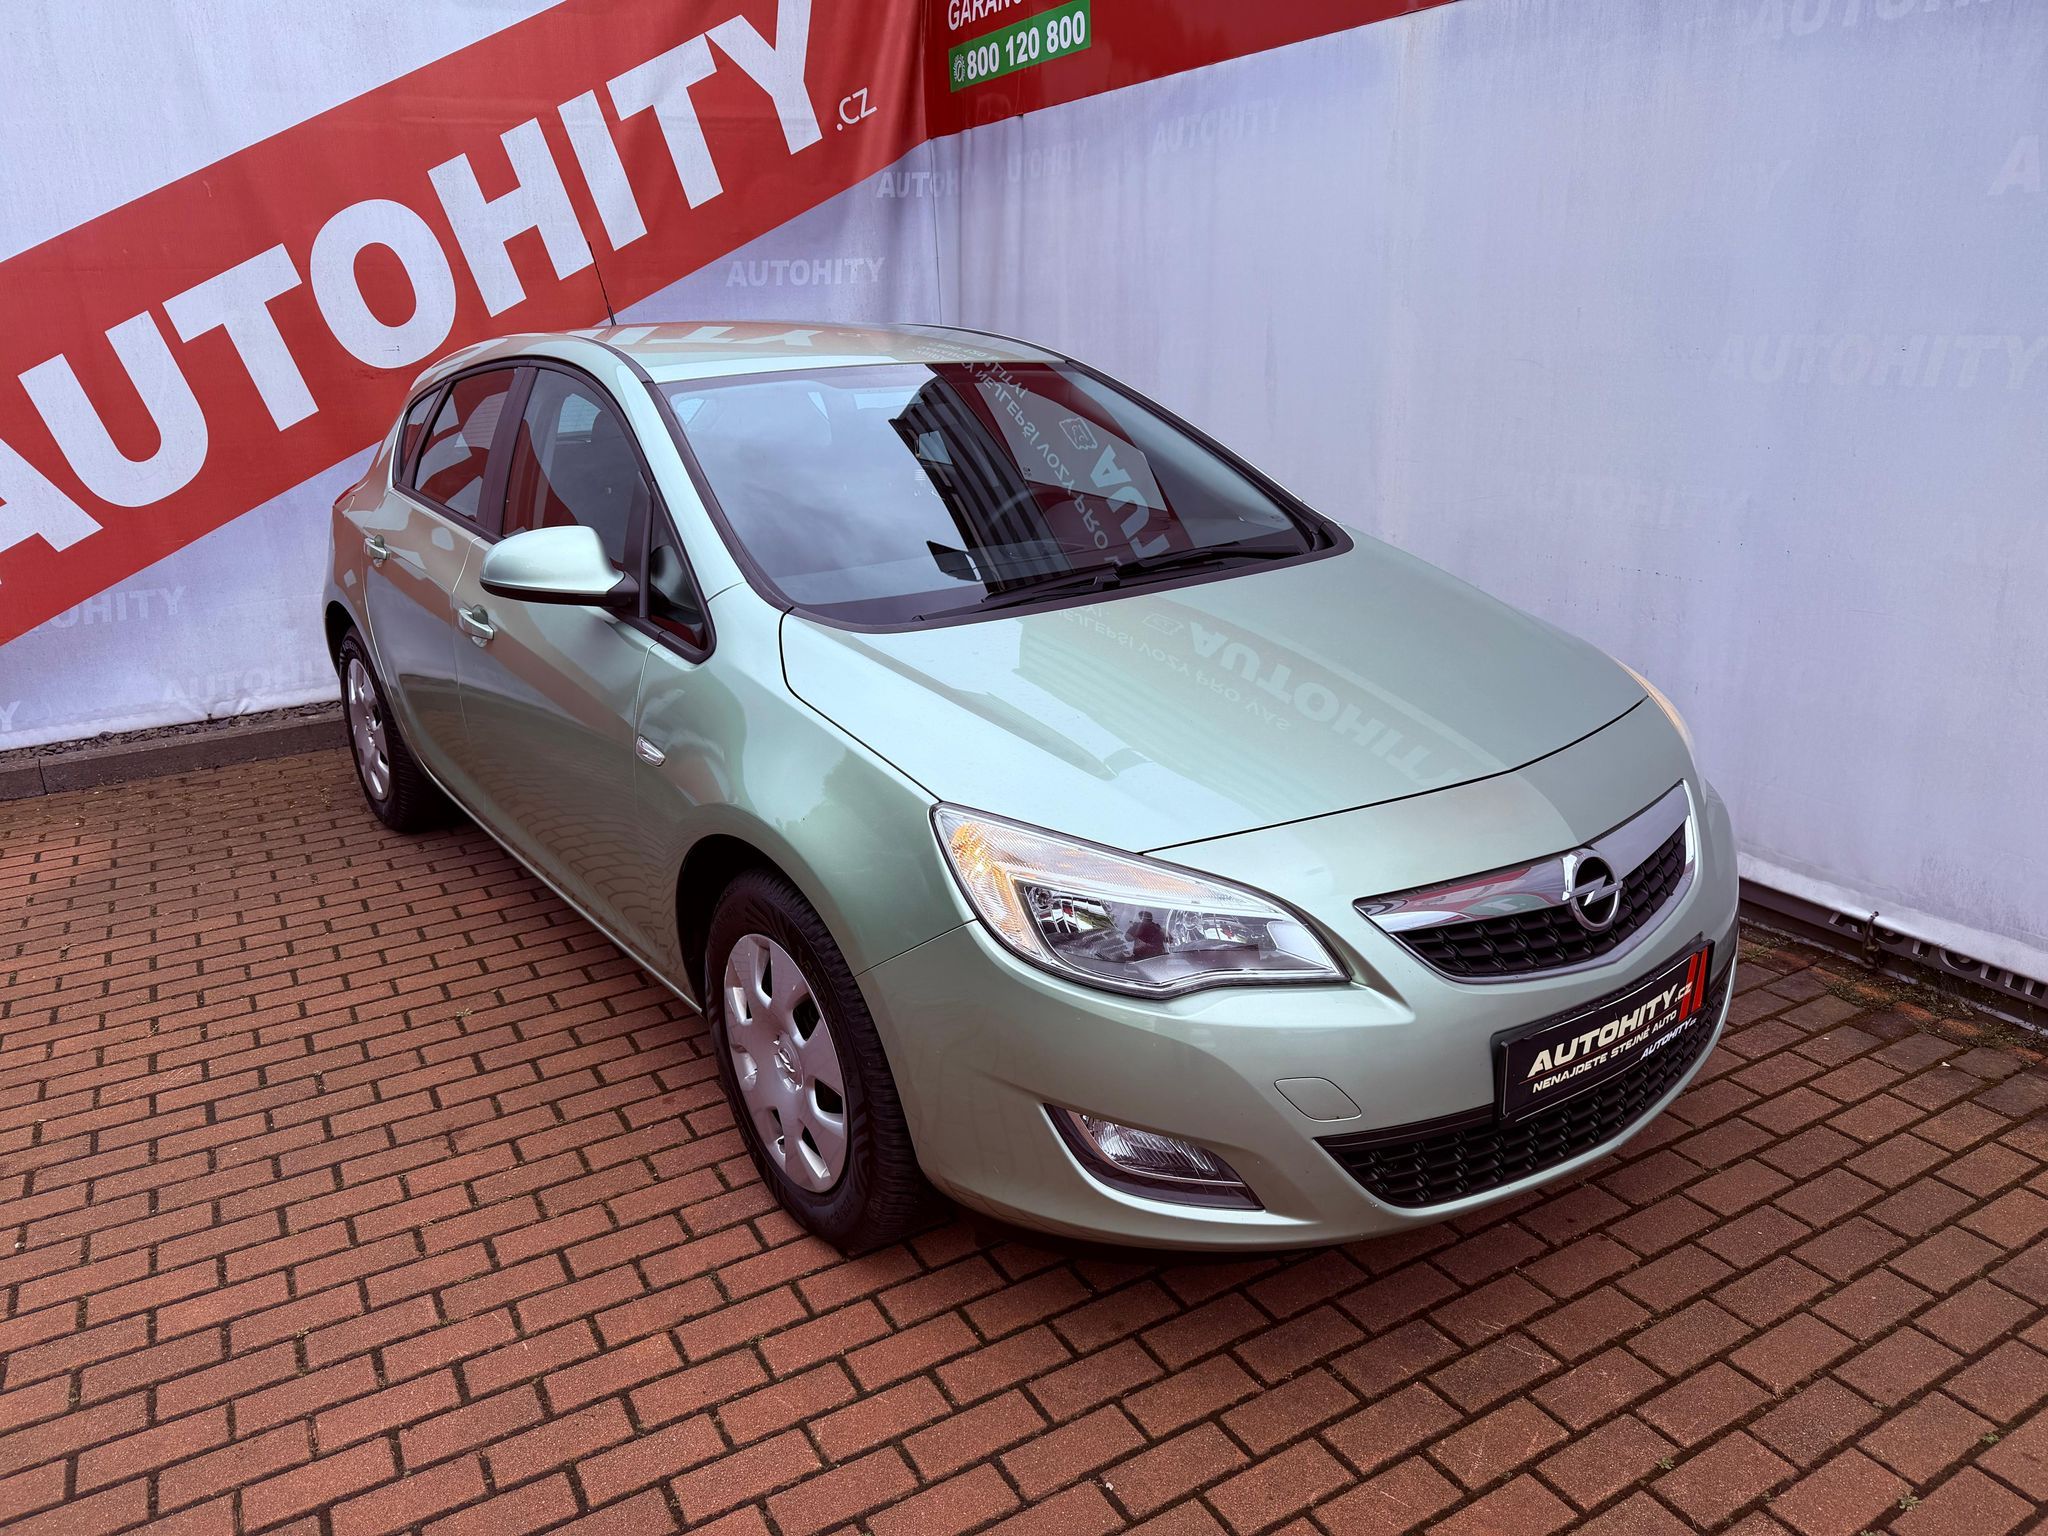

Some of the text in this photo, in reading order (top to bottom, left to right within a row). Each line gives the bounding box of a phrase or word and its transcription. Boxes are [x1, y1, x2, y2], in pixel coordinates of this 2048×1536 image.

[967, 10, 1086, 80] 800 120 800
[725, 256, 886, 288] AUTOHITY
[1532, 1009, 1678, 1094] NENAJDETE STEJNÉ AUTO
